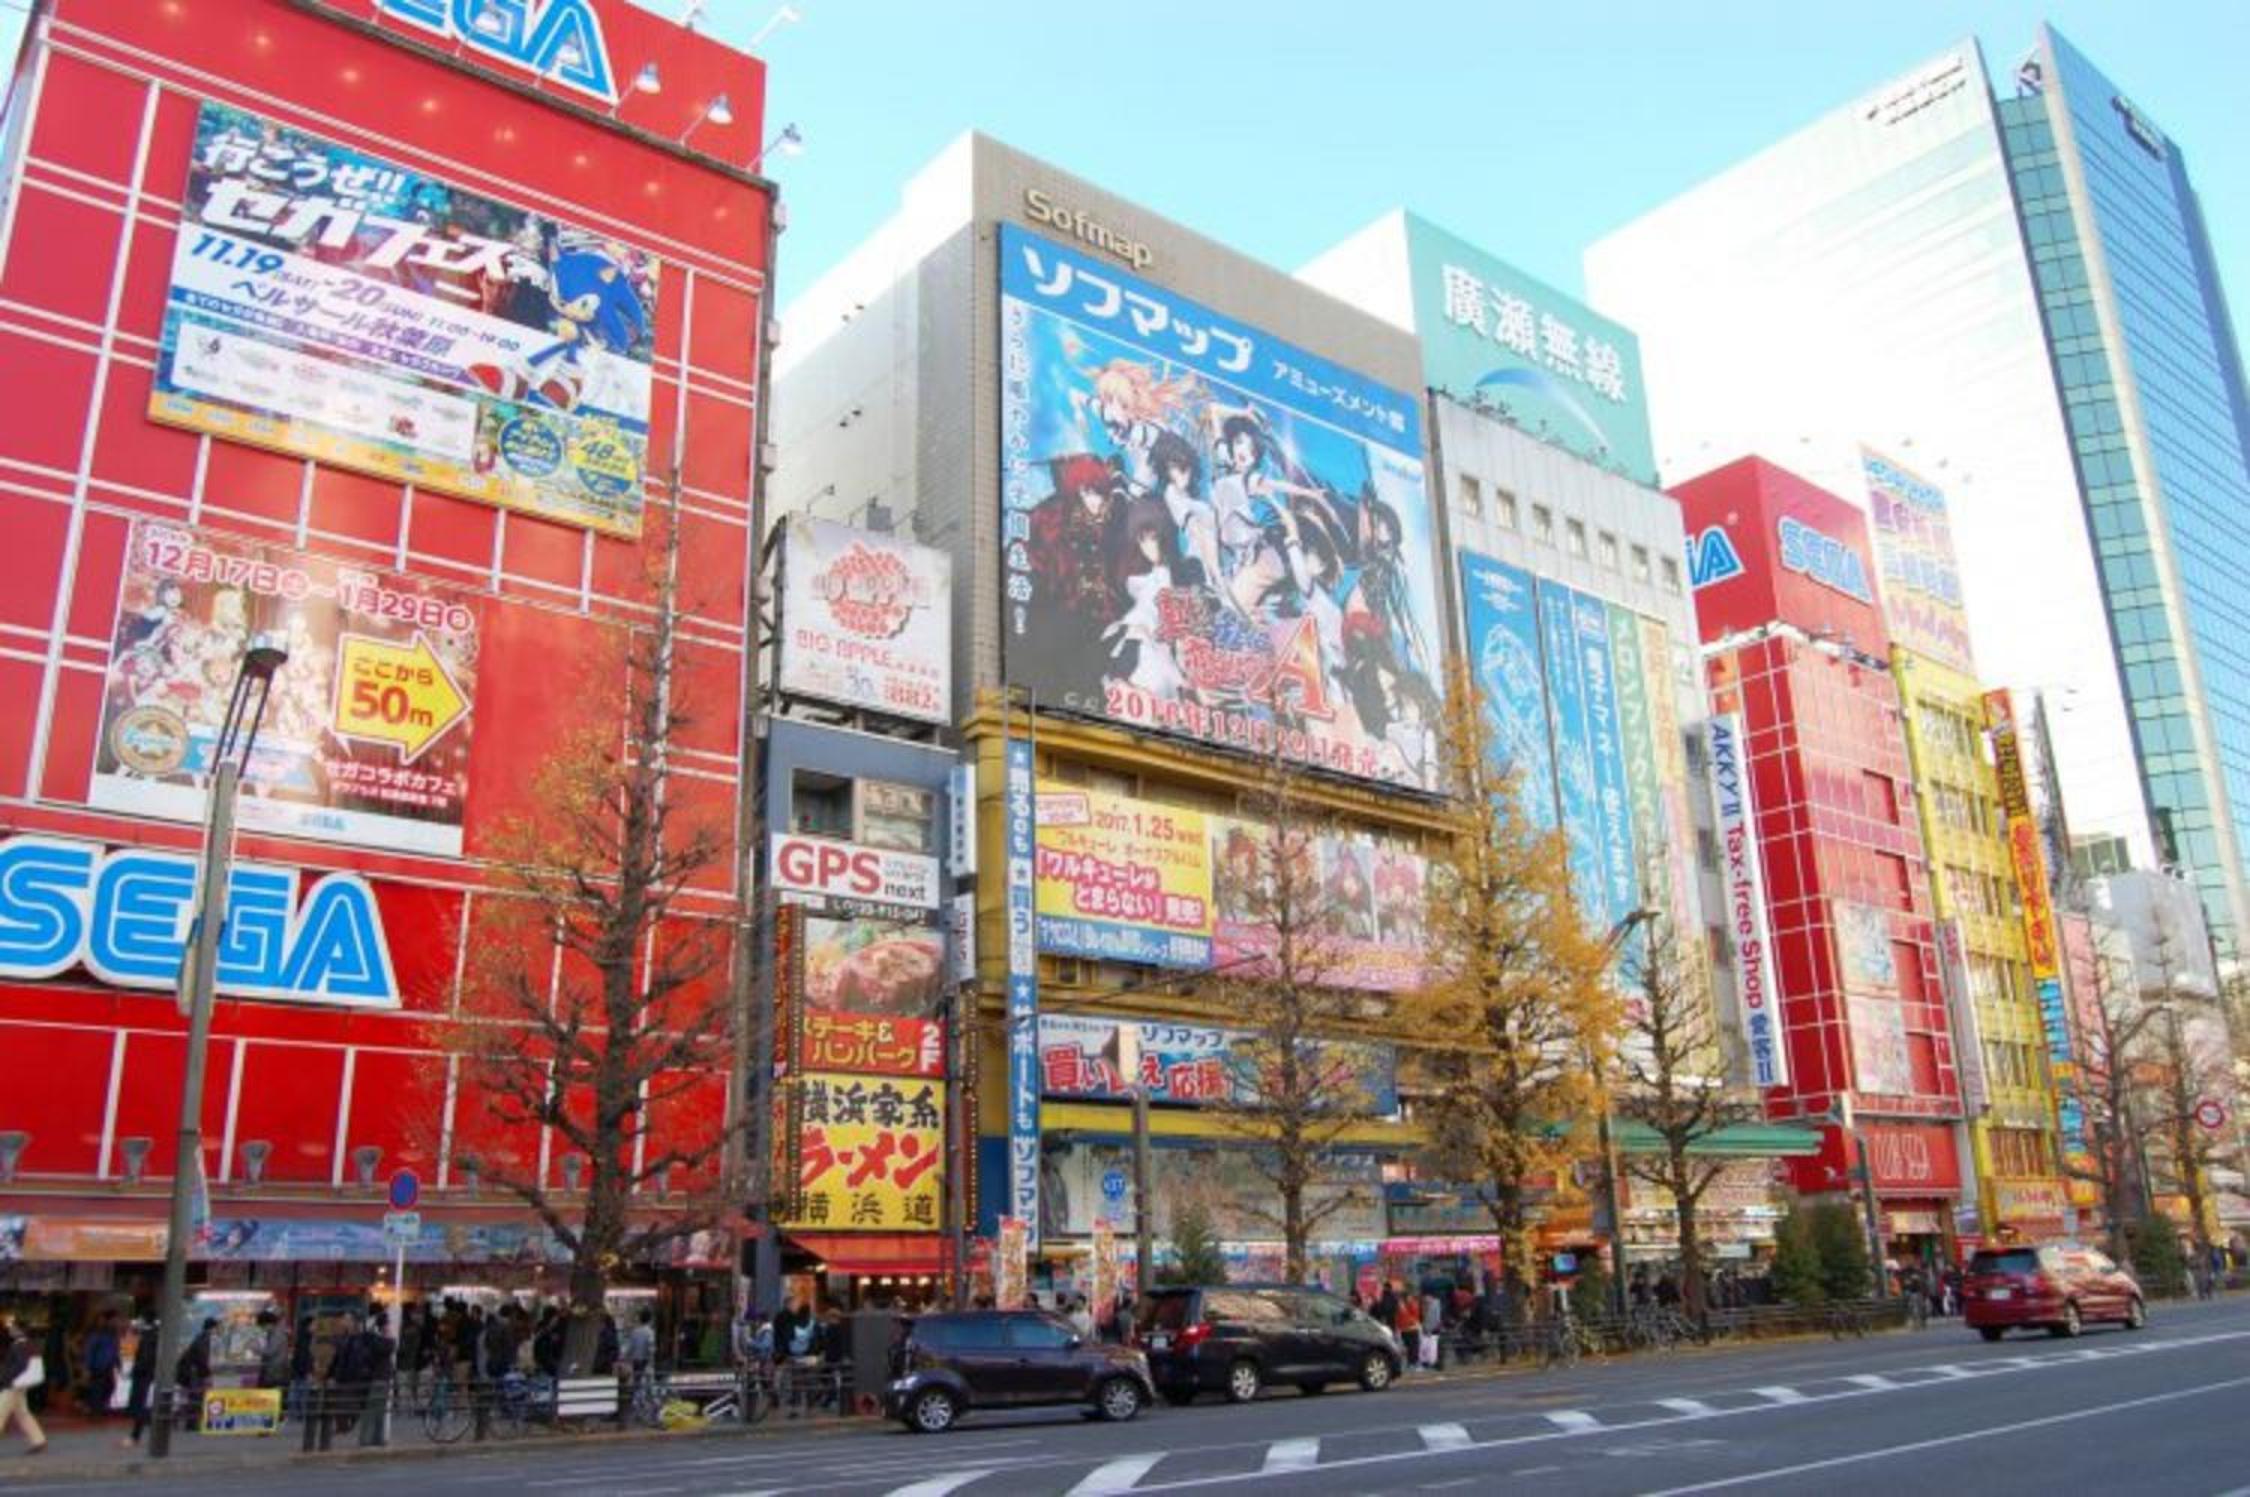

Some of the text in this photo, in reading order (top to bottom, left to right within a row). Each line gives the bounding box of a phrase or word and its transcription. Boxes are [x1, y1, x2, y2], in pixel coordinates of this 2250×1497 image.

[191, 232, 286, 276] 11.19
[1024, 188, 1154, 270] Sofmap
[1022, 245, 1255, 375] ソフマップ
[350, 655, 437, 688] ここから
[1712, 722, 1740, 799] AKKY
[778, 840, 883, 895] GPS
[884, 880, 927, 902] next
[1726, 820, 1762, 936] Tax-free
[0, 836, 402, 1008] SEGA
[1739, 939, 1766, 1011] Shop
[918, 1021, 944, 1072] 2F
[1142, 1025, 1222, 1048] ソフマップ
[800, 1125, 940, 1190] ラーメン
